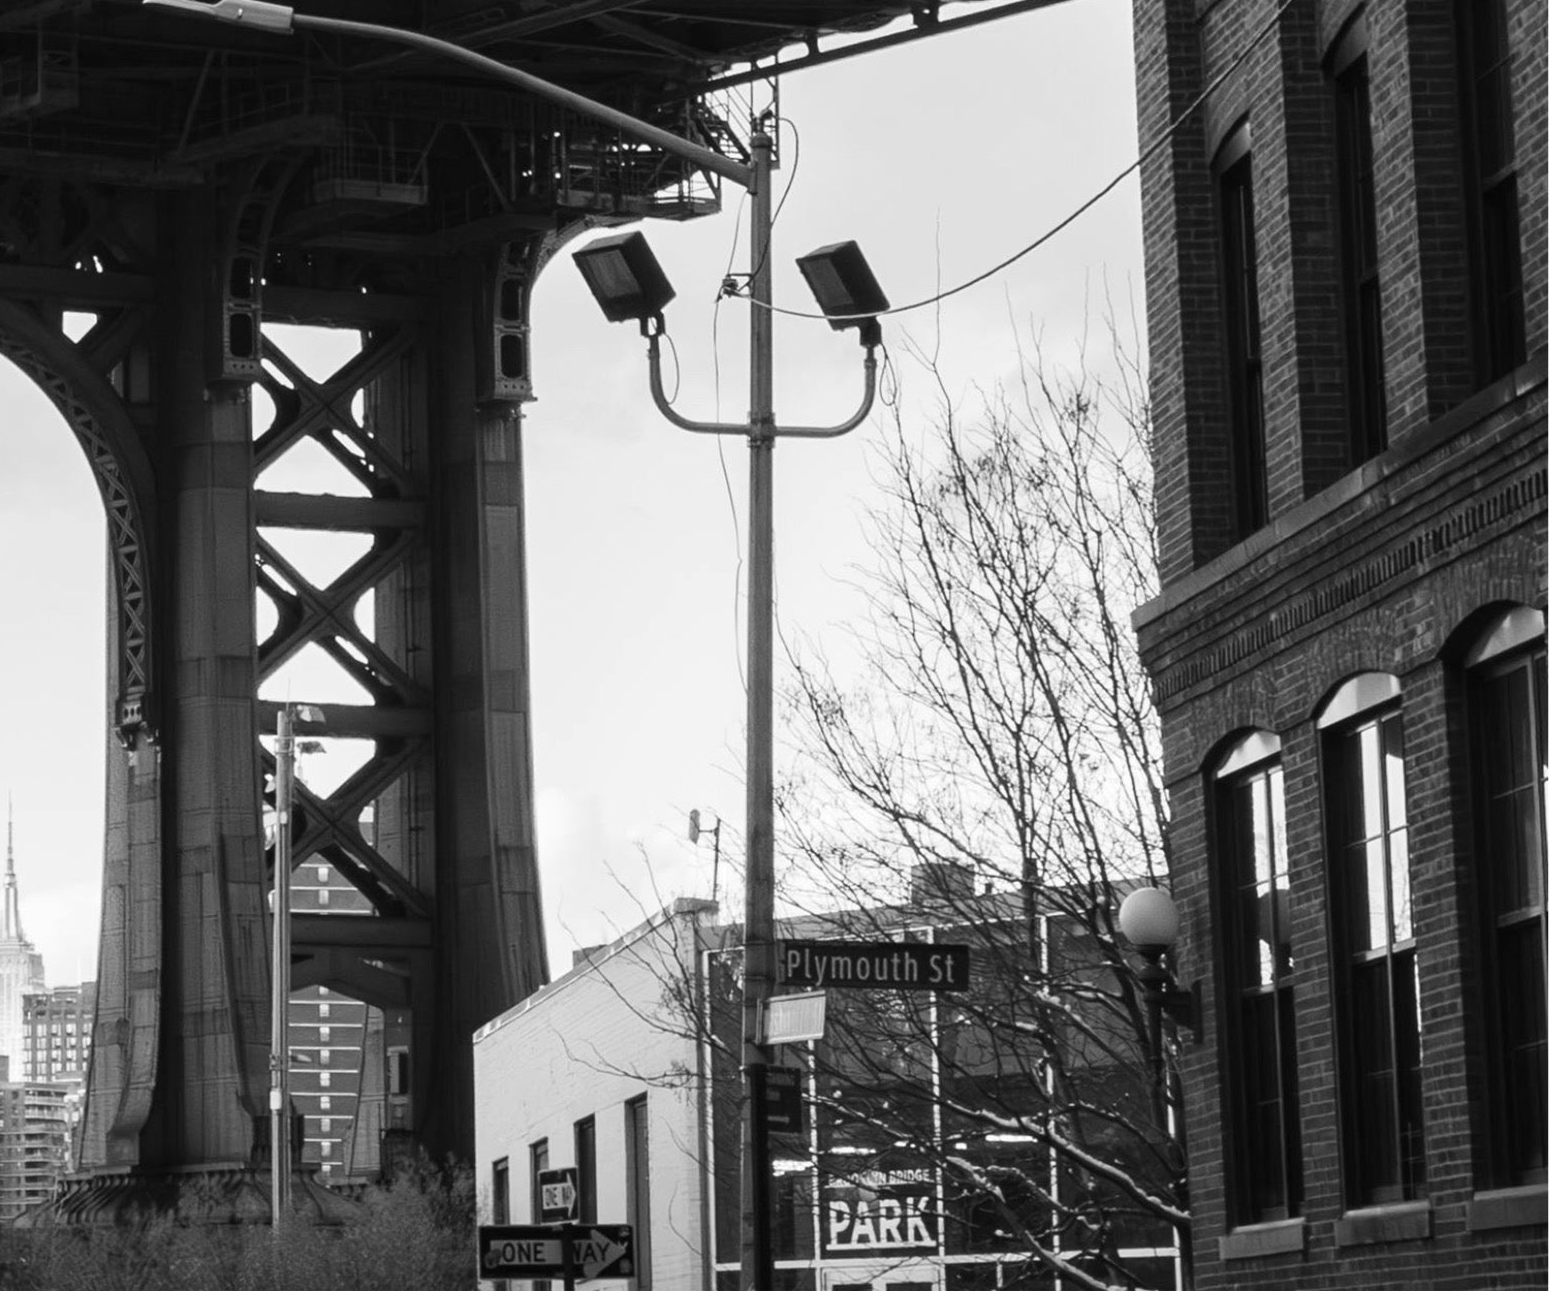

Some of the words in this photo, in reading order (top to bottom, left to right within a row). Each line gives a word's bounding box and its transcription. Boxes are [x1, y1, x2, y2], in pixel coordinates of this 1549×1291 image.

[787, 948, 918, 986] Plymouth
[929, 954, 955, 984] St
[889, 1168, 930, 1185] BRIDGE
[829, 1196, 932, 1245] PARK
[502, 1242, 546, 1263] ONE
